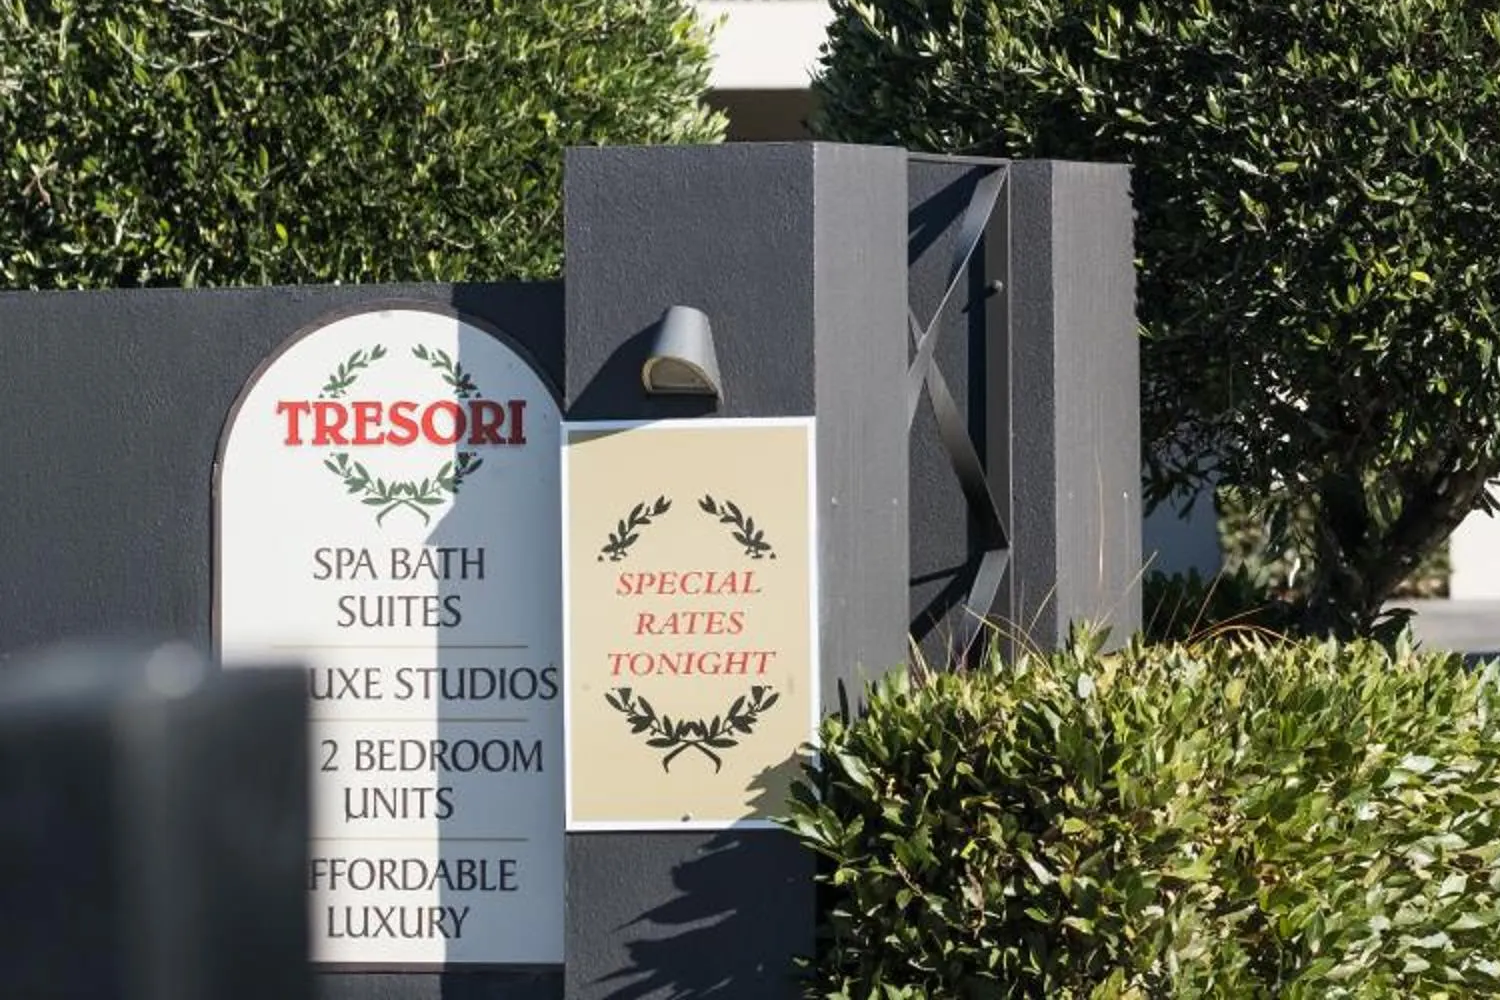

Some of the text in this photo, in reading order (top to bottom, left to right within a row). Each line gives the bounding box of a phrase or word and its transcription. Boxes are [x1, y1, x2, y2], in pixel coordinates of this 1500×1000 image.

[275, 400, 527, 446] TRESORI
[312, 547, 486, 580] SPA BATH
[615, 570, 762, 596] SPECIAL
[336, 594, 462, 628] SUITES
[634, 610, 745, 636] RATES
[607, 651, 777, 677] TONIGHT
[307, 665, 560, 701] UXE STUDIOS
[319, 738, 545, 773] 2 BEDROOM
[343, 786, 455, 823] UNITS
[306, 857, 520, 892] FFORDABLE
[326, 905, 470, 941] LUXURY
